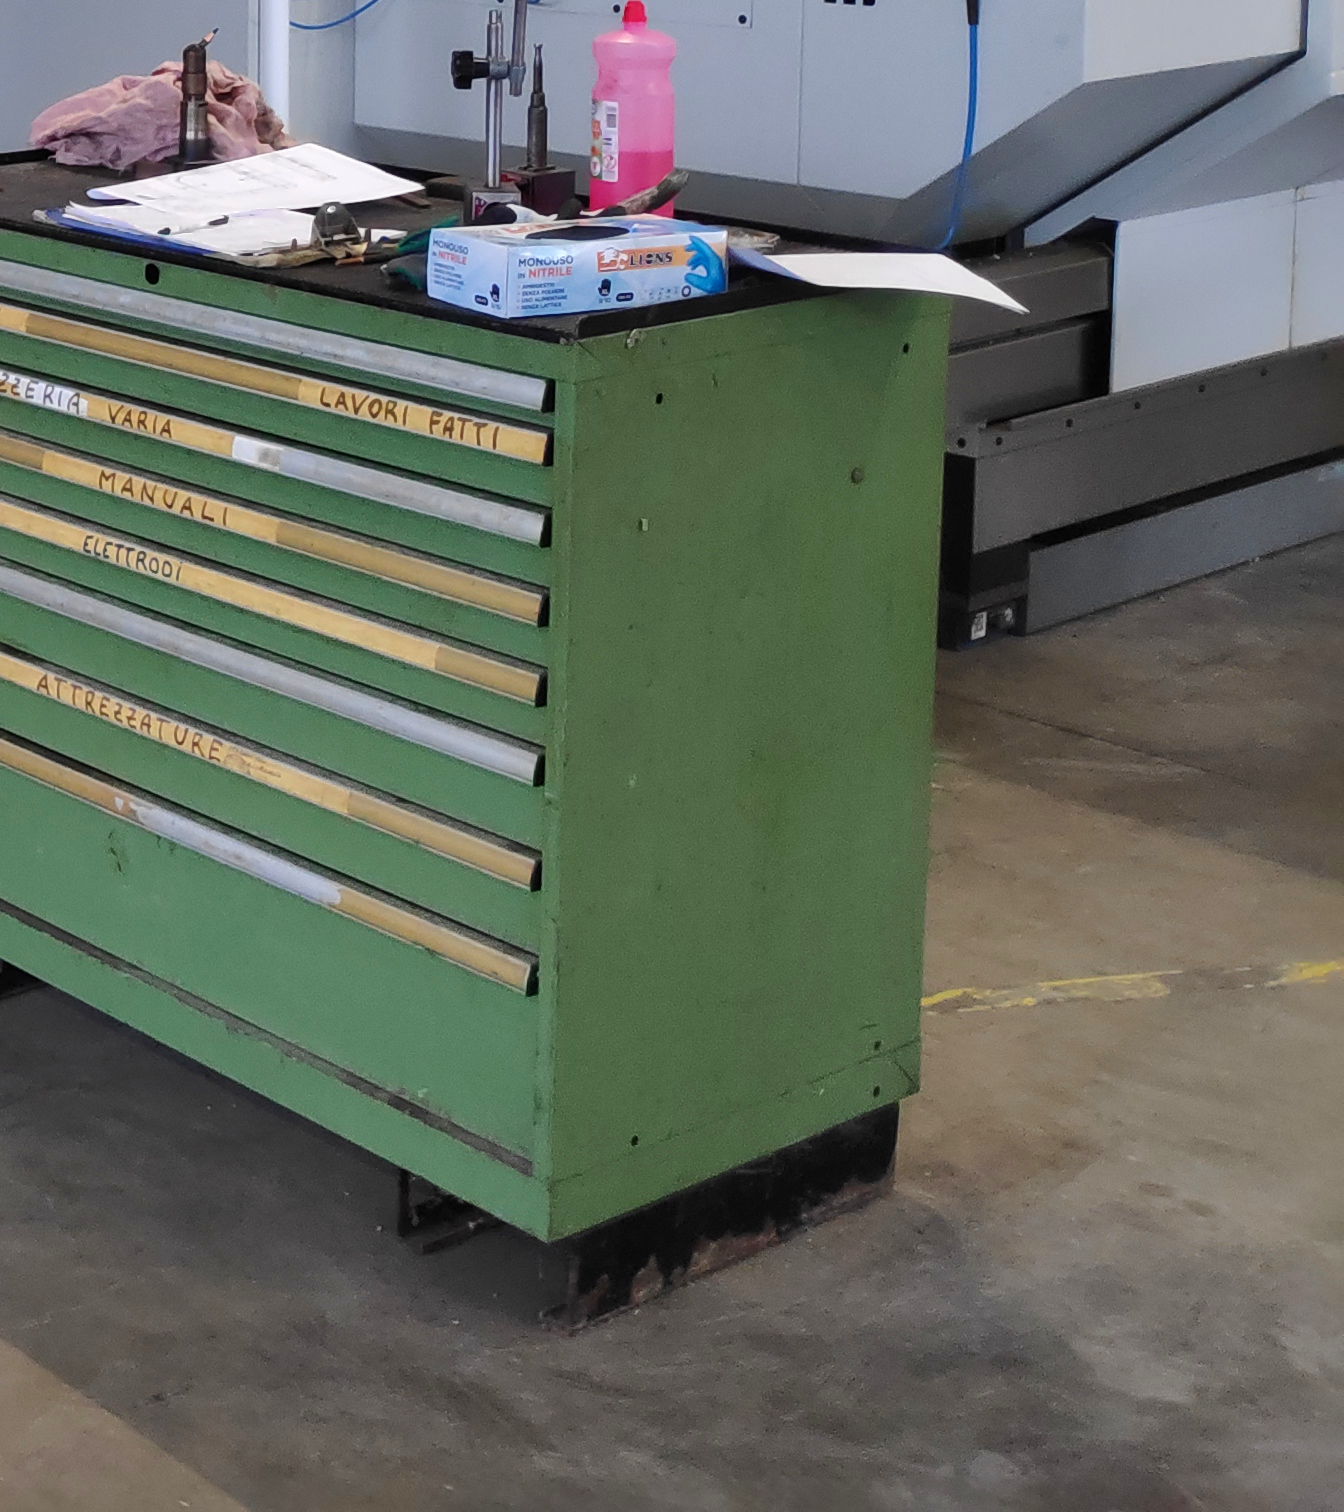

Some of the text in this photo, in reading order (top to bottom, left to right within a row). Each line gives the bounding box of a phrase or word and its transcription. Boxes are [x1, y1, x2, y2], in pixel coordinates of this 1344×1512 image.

[518, 254, 574, 268] MONOUSO
[528, 266, 573, 279] NITRILE
[629, 251, 673, 267] LIONS
[107, 404, 173, 438] VARIA
[320, 387, 500, 450] LAVORI FATTI
[98, 469, 228, 526] MANUALI
[36, 674, 224, 763] ATTREZZATURE
